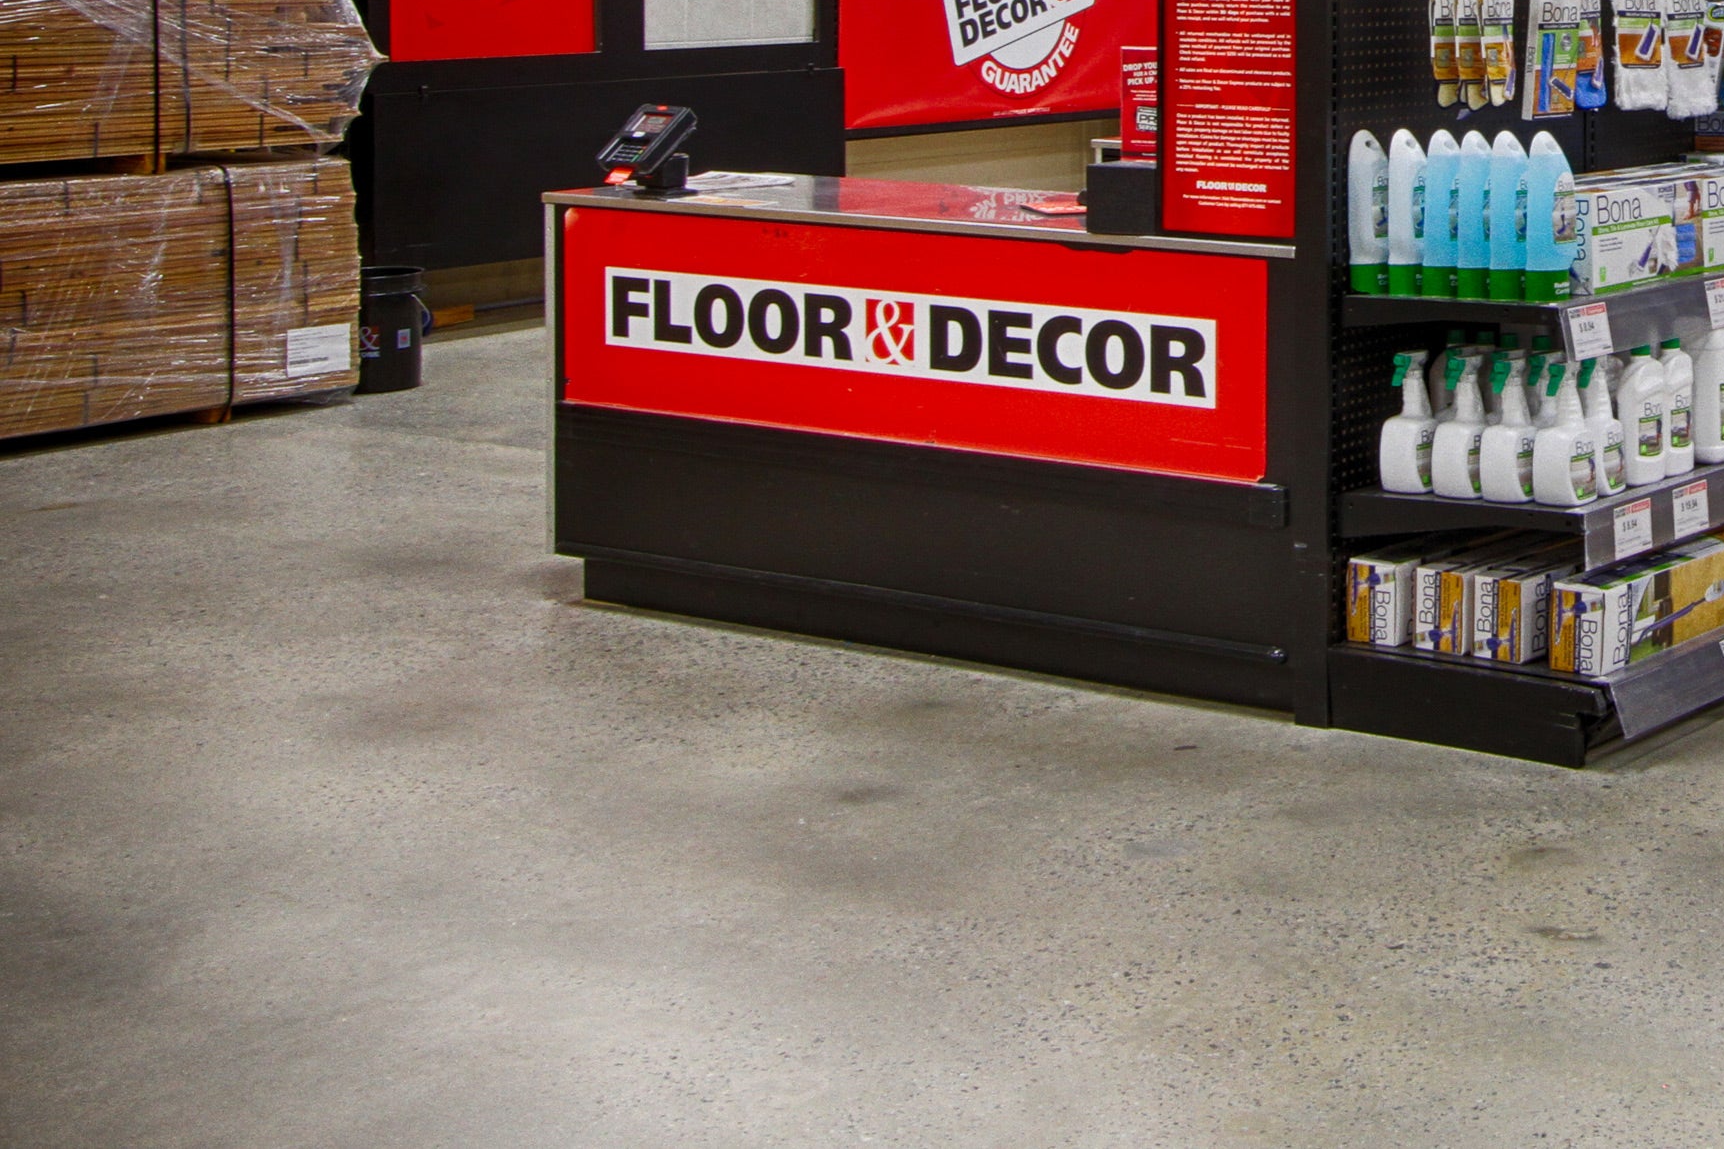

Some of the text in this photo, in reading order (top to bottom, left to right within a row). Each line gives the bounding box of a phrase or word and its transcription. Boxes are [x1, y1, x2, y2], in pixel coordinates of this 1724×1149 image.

[1543, 1, 1578, 23] Bona
[980, 21, 1080, 94] GUARANTEE
[1196, 180, 1229, 191] FLOOR
[1234, 183, 1268, 193] DECOR
[1597, 195, 1643, 225] Bona
[1575, 199, 1590, 262] Bona
[611, 274, 1208, 400] FLOOR & DECOR
[1375, 589, 1392, 641] Bona
[1419, 573, 1436, 625] Bona
[1476, 581, 1493, 633] Bona
[1531, 580, 1547, 653] Bona
[1581, 618, 1598, 672] Bona
[1612, 592, 1628, 665] Bona
